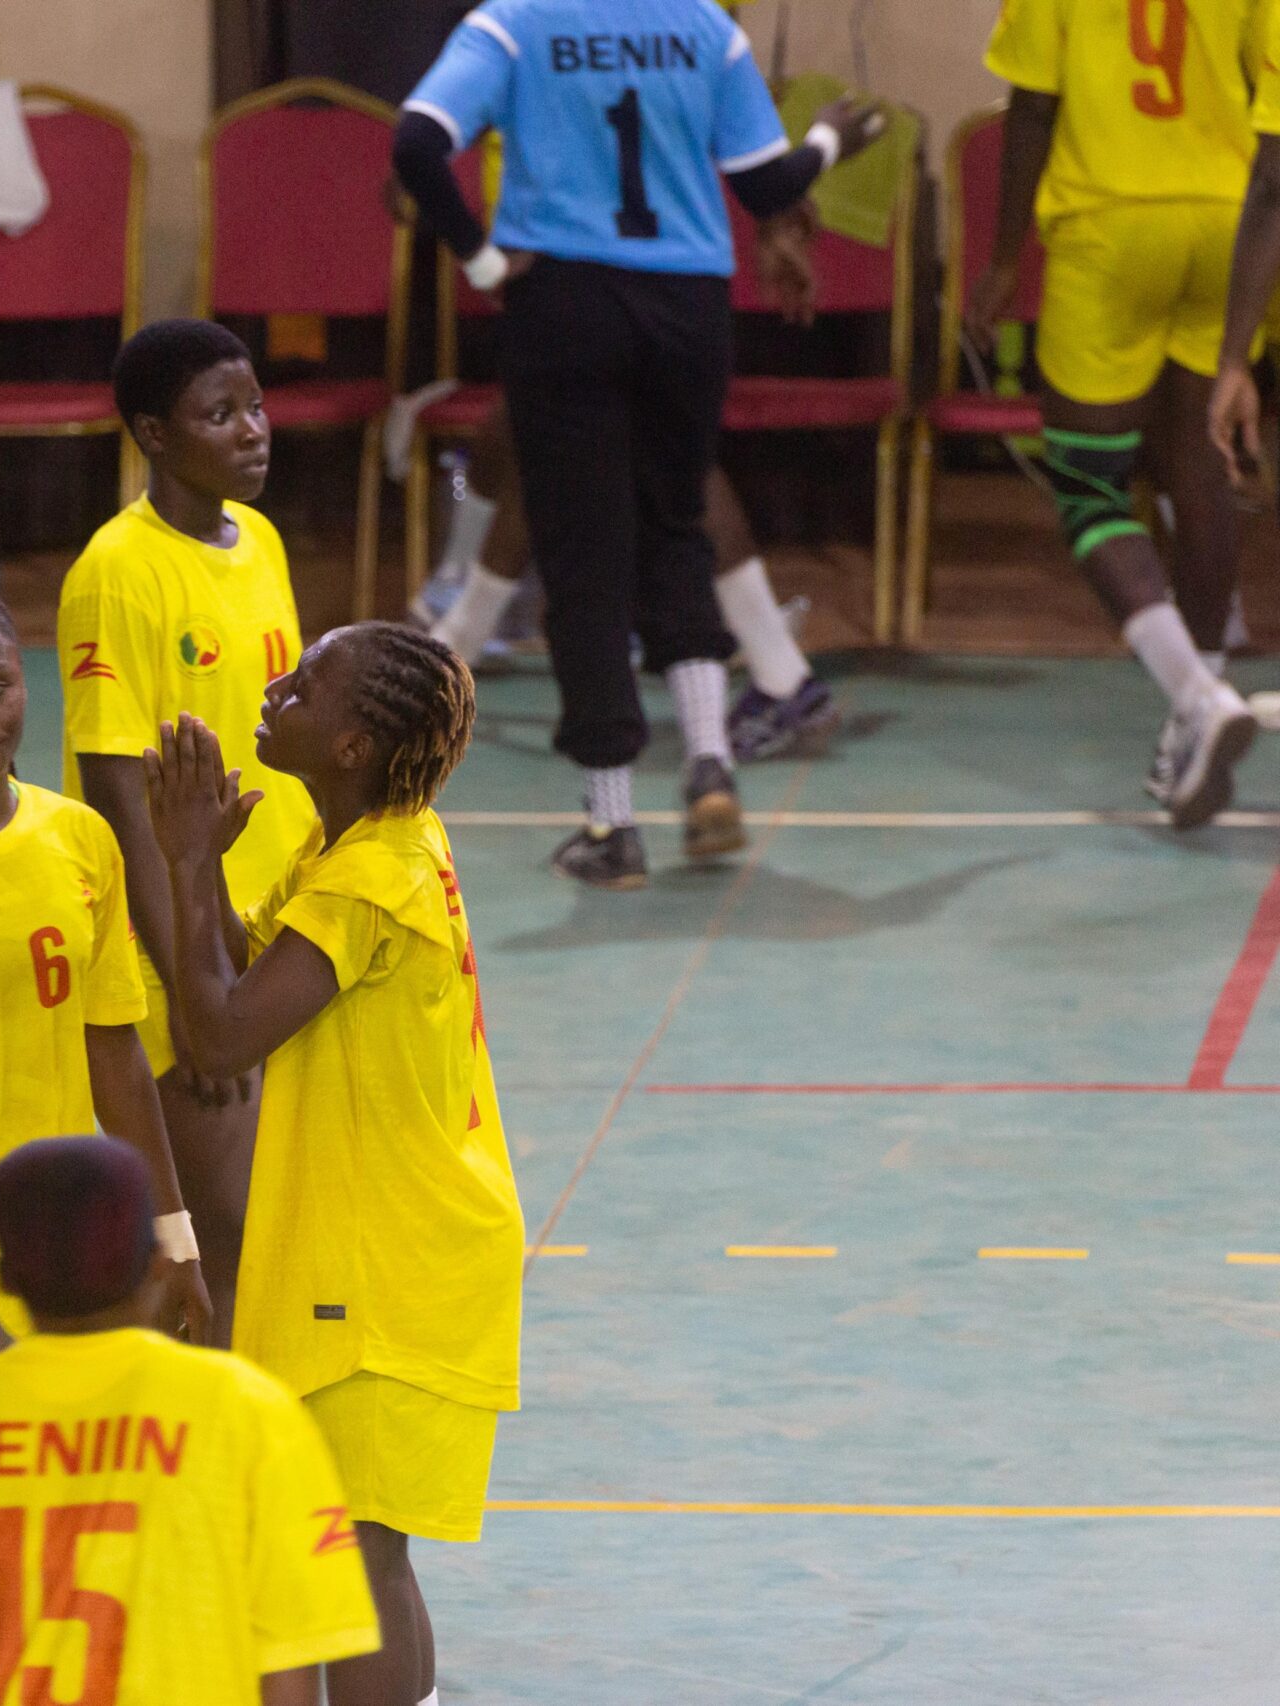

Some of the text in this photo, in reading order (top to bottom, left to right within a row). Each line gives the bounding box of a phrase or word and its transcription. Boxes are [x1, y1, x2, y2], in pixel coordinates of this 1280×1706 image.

[550, 34, 699, 72] BENIN
[1128, 0, 1187, 120] 9
[606, 87, 660, 239] 1
[29, 926, 71, 1008] 6
